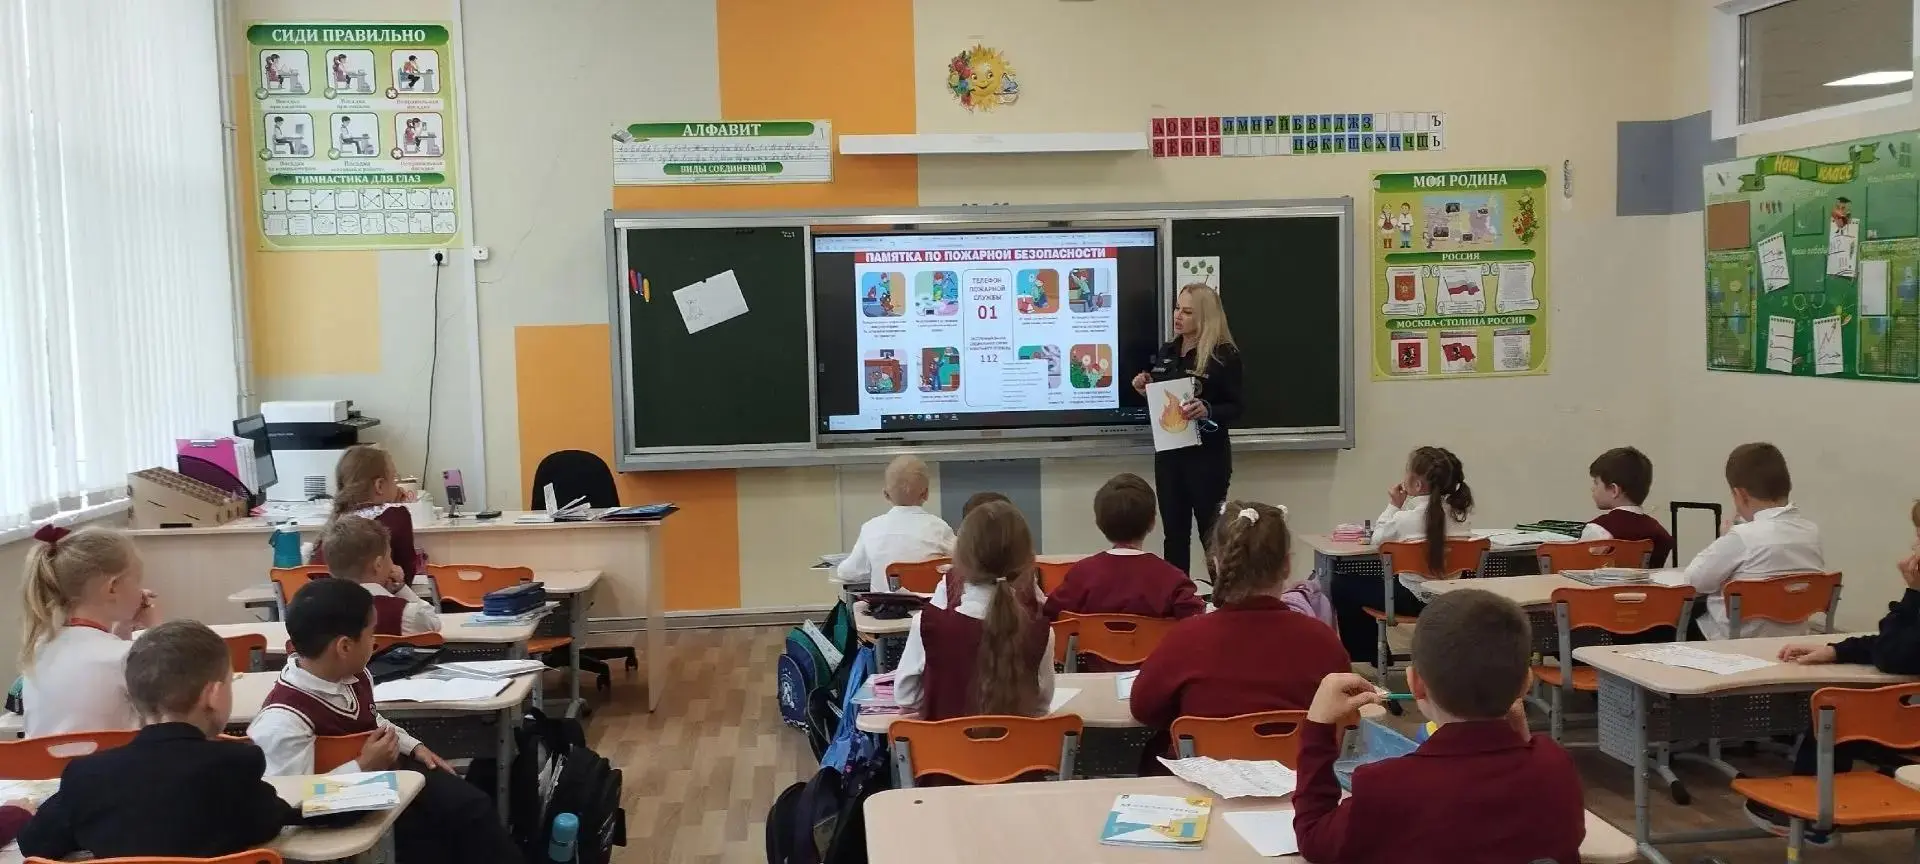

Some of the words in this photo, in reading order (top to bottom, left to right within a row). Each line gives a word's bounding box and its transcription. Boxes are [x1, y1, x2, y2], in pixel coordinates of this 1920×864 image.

[272, 29, 318, 44] СИДИ
[322, 29, 426, 42] ПРАВИЛЬНО
[683, 124, 762, 137] АЛФАВИТ
[680, 165, 707, 174] ВИДЫ
[708, 163, 767, 173] СОЕДИНЕНИЙ
[1774, 155, 1800, 174] Наш
[295, 175, 369, 184] ГИМНАСТИКА
[372, 175, 393, 184] ДЛЯ
[395, 175, 421, 184] ГЛАЗ
[1413, 175, 1446, 188] МОЯ
[1449, 173, 1508, 188] РОДИНА
[865, 251, 922, 263] ПАМЯТКА
[924, 250, 942, 262] ПО
[944, 249, 1012, 261] ПОЖАРНОЙ
[1014, 247, 1107, 260] БЕЗОПАСНОСТИ
[1442, 252, 1480, 261] РОССИЯ
[977, 305, 998, 320] 01
[1396, 319, 1486, 329] МОСКВА-СТОЛИЦА
[1487, 316, 1526, 326] РОССИИ
[981, 354, 998, 363] 112
